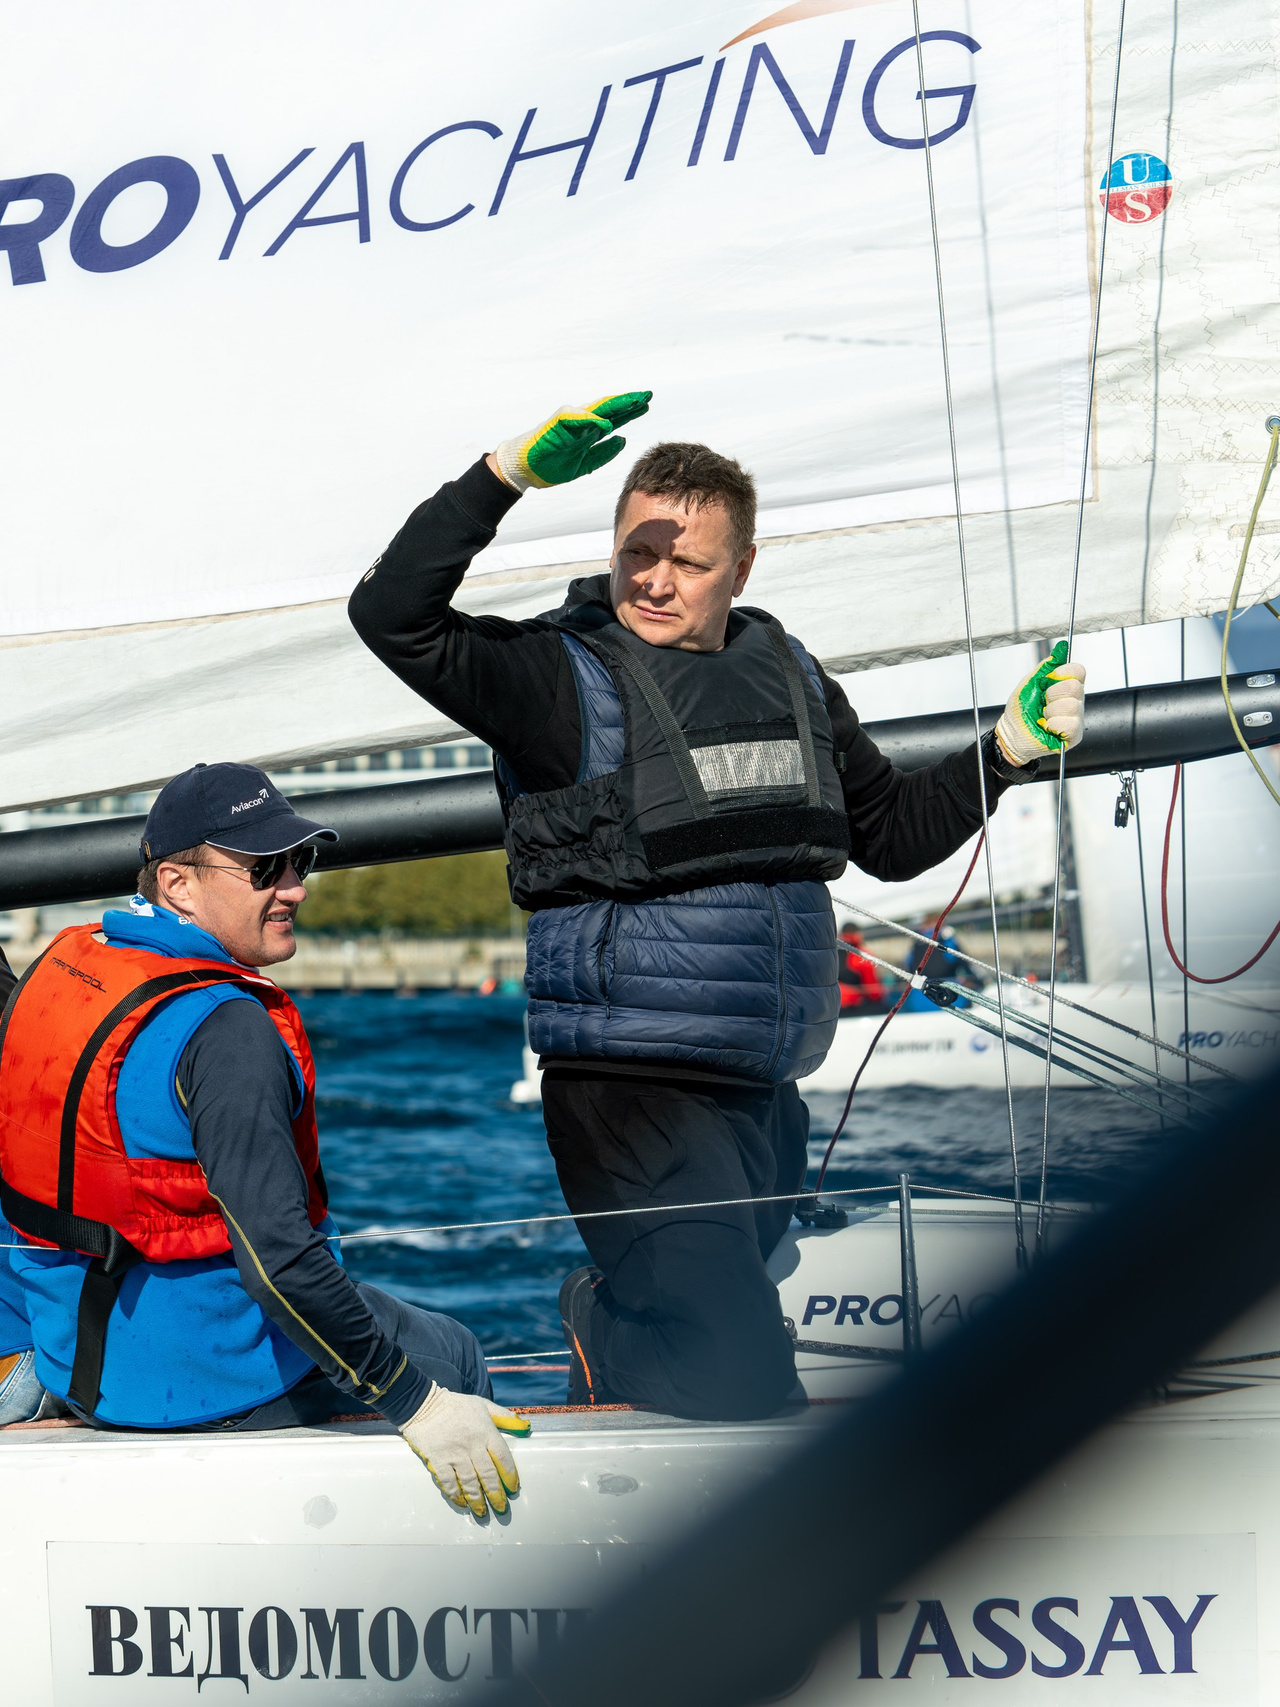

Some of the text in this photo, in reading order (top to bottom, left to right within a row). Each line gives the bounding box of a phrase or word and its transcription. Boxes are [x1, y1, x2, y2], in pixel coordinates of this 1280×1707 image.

[1119, 155, 1153, 185] U
[1124, 191, 1152, 223] S
[231, 797, 264, 815] Aviacon
[850, 1593, 1219, 1680] TASSAY
